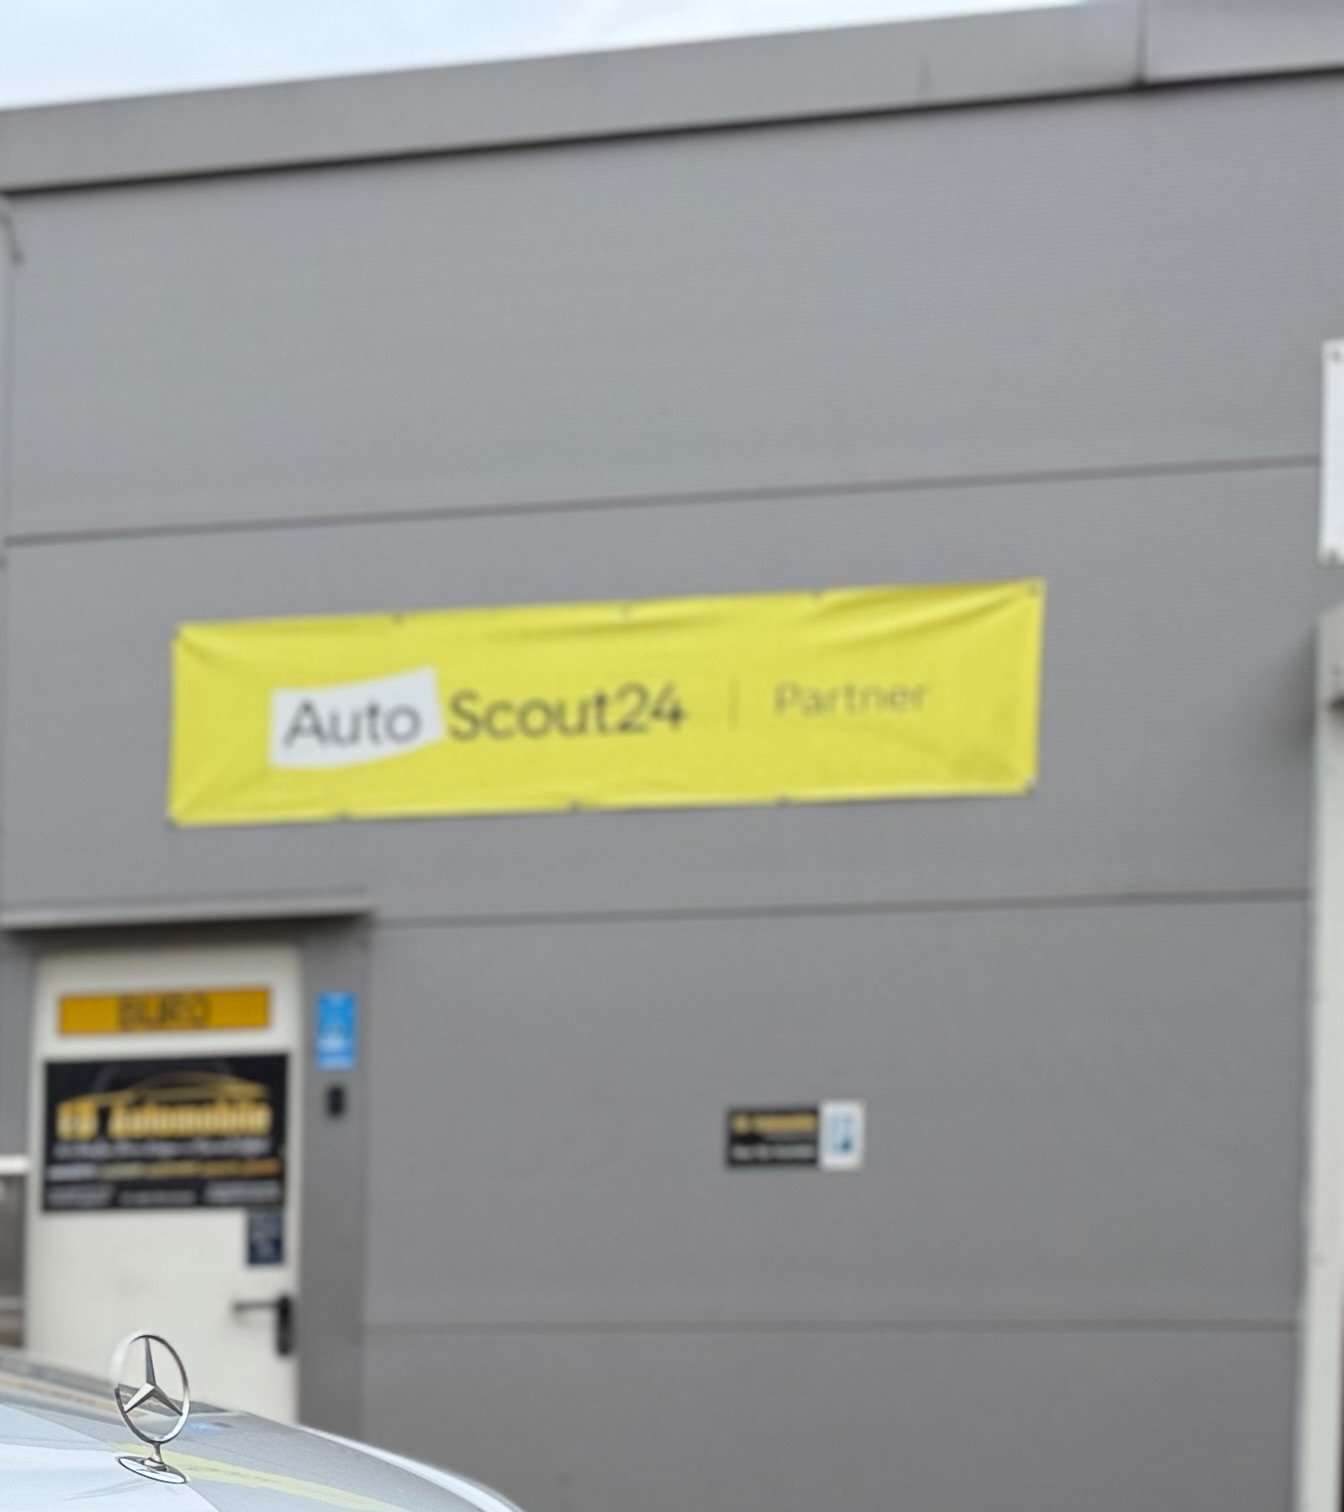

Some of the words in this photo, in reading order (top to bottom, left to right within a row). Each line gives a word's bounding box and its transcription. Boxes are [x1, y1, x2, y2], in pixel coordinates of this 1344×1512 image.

[282, 698, 423, 750] Auto
[448, 681, 689, 742] Scout24
[772, 682, 928, 716] Partner
